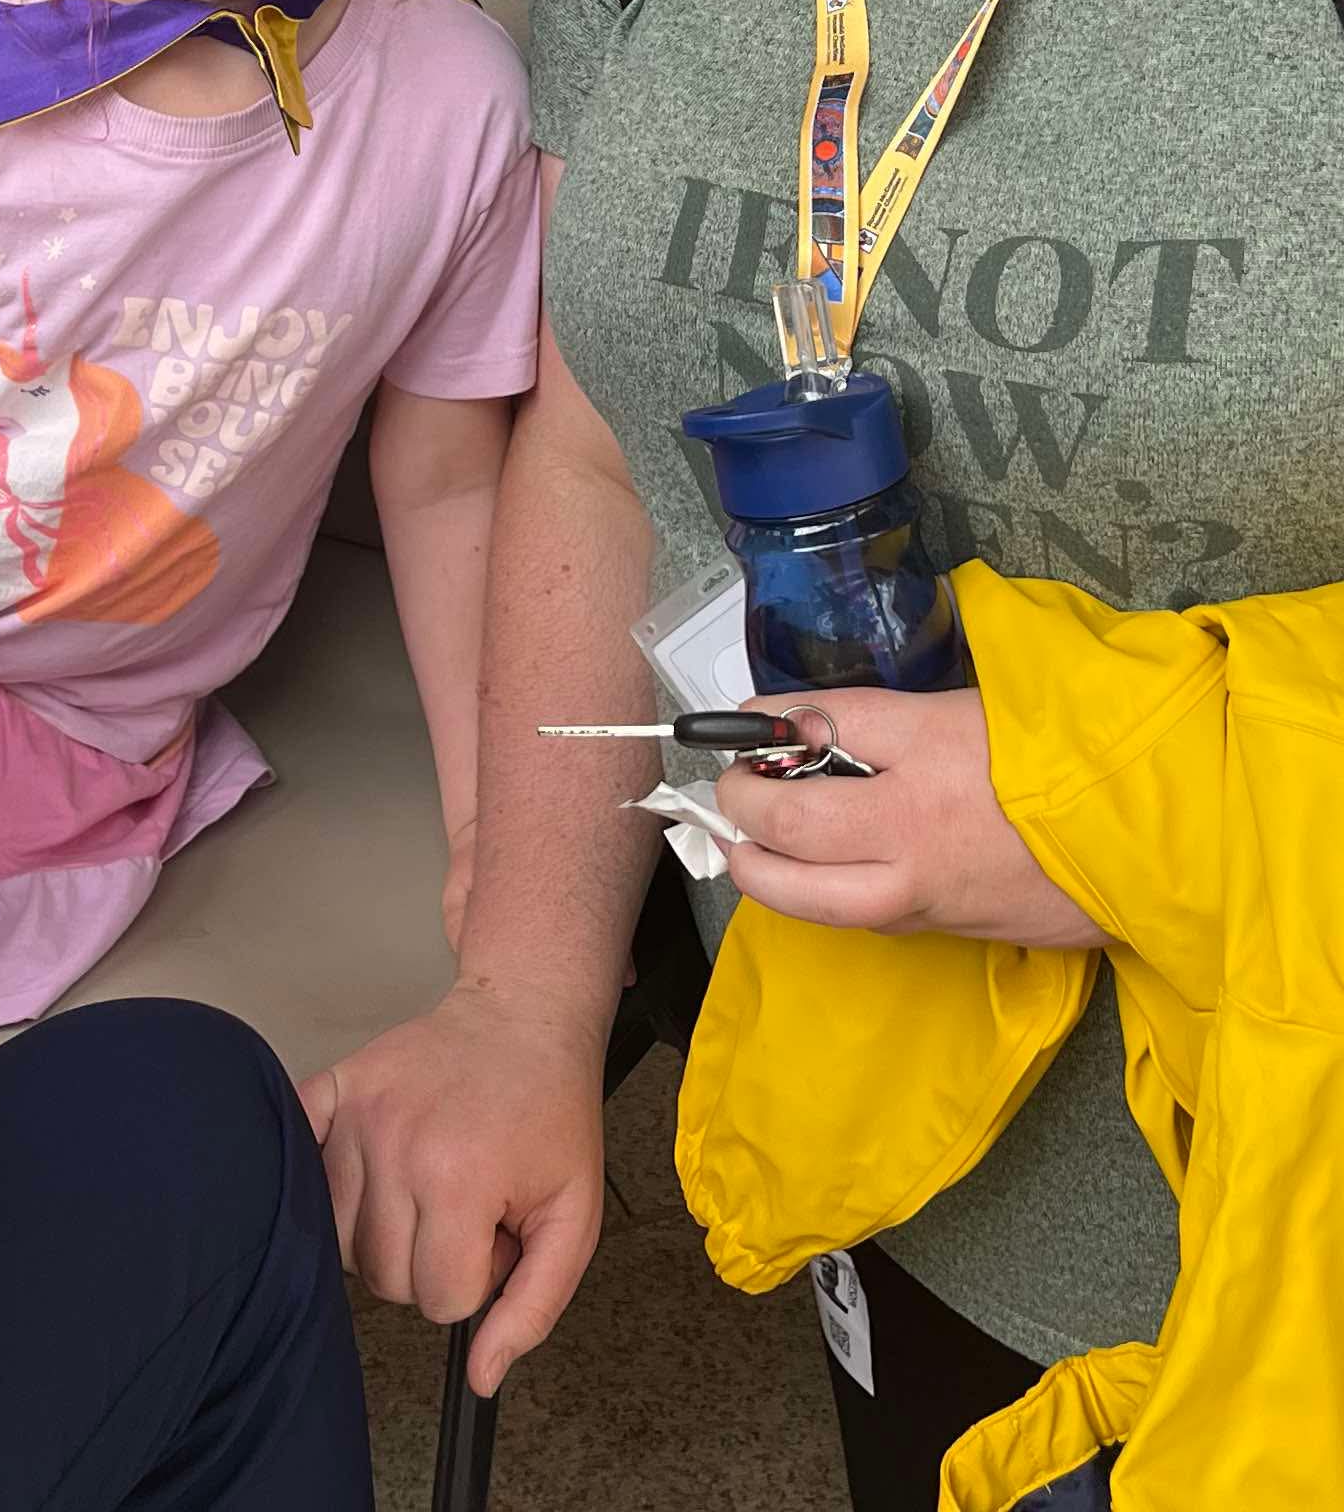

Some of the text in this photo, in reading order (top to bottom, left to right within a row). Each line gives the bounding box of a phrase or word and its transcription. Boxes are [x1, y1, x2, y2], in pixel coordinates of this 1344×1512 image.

[652, 177, 799, 305] IF
[112, 296, 353, 365] ENJOY
[150, 400, 296, 453] OU
